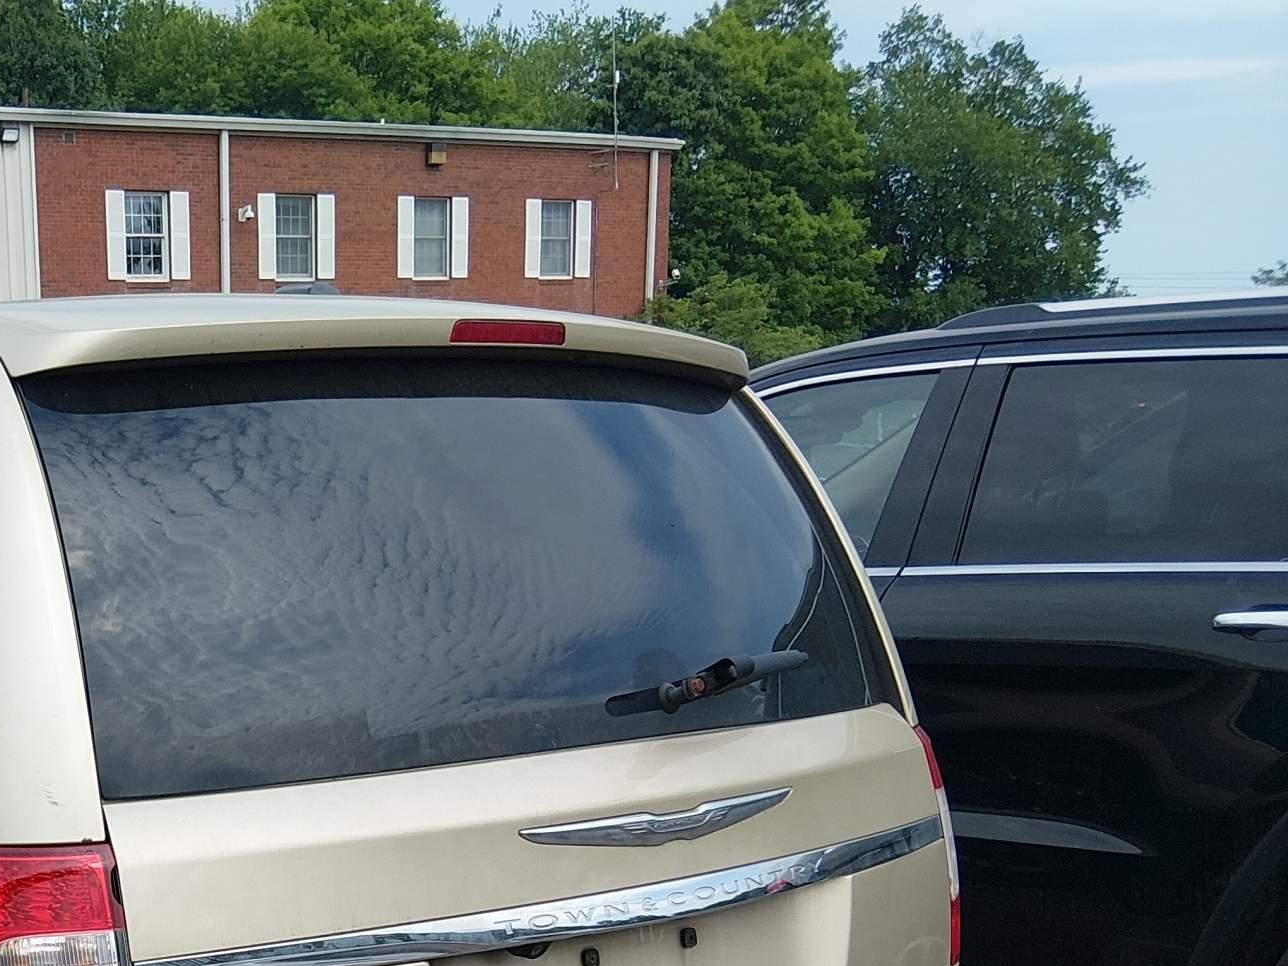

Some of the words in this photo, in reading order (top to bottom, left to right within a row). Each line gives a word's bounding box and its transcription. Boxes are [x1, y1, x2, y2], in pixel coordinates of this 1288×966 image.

[494, 902, 630, 935] TOWN
[641, 896, 659, 912] &
[667, 858, 824, 905] COUNTRY
